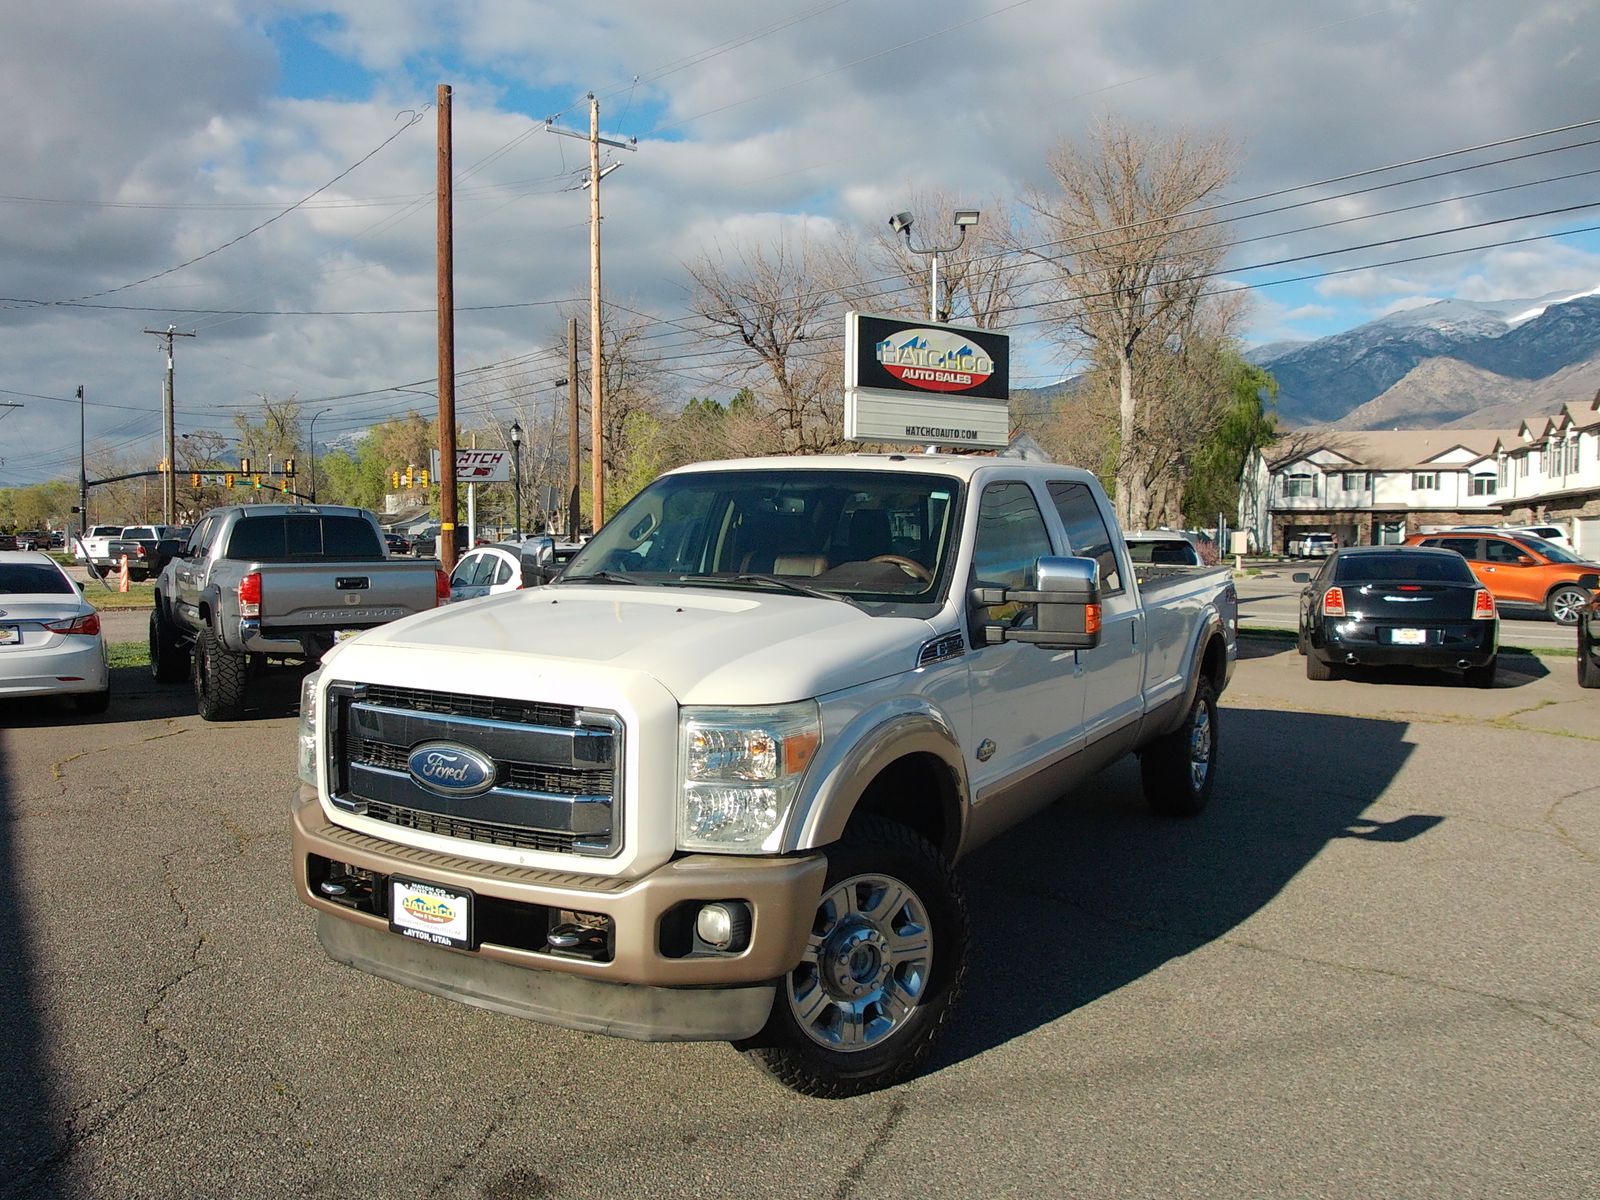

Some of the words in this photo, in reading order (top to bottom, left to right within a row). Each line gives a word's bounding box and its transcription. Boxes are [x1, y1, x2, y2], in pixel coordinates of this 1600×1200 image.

[876, 341, 994, 374] HATCHCO
[902, 368, 934, 381] AUTO
[936, 371, 972, 384] SALES
[905, 426, 978, 439] HATCHCOAUTO.COM
[457, 452, 503, 464] ATCH
[422, 752, 470, 781] Ford
